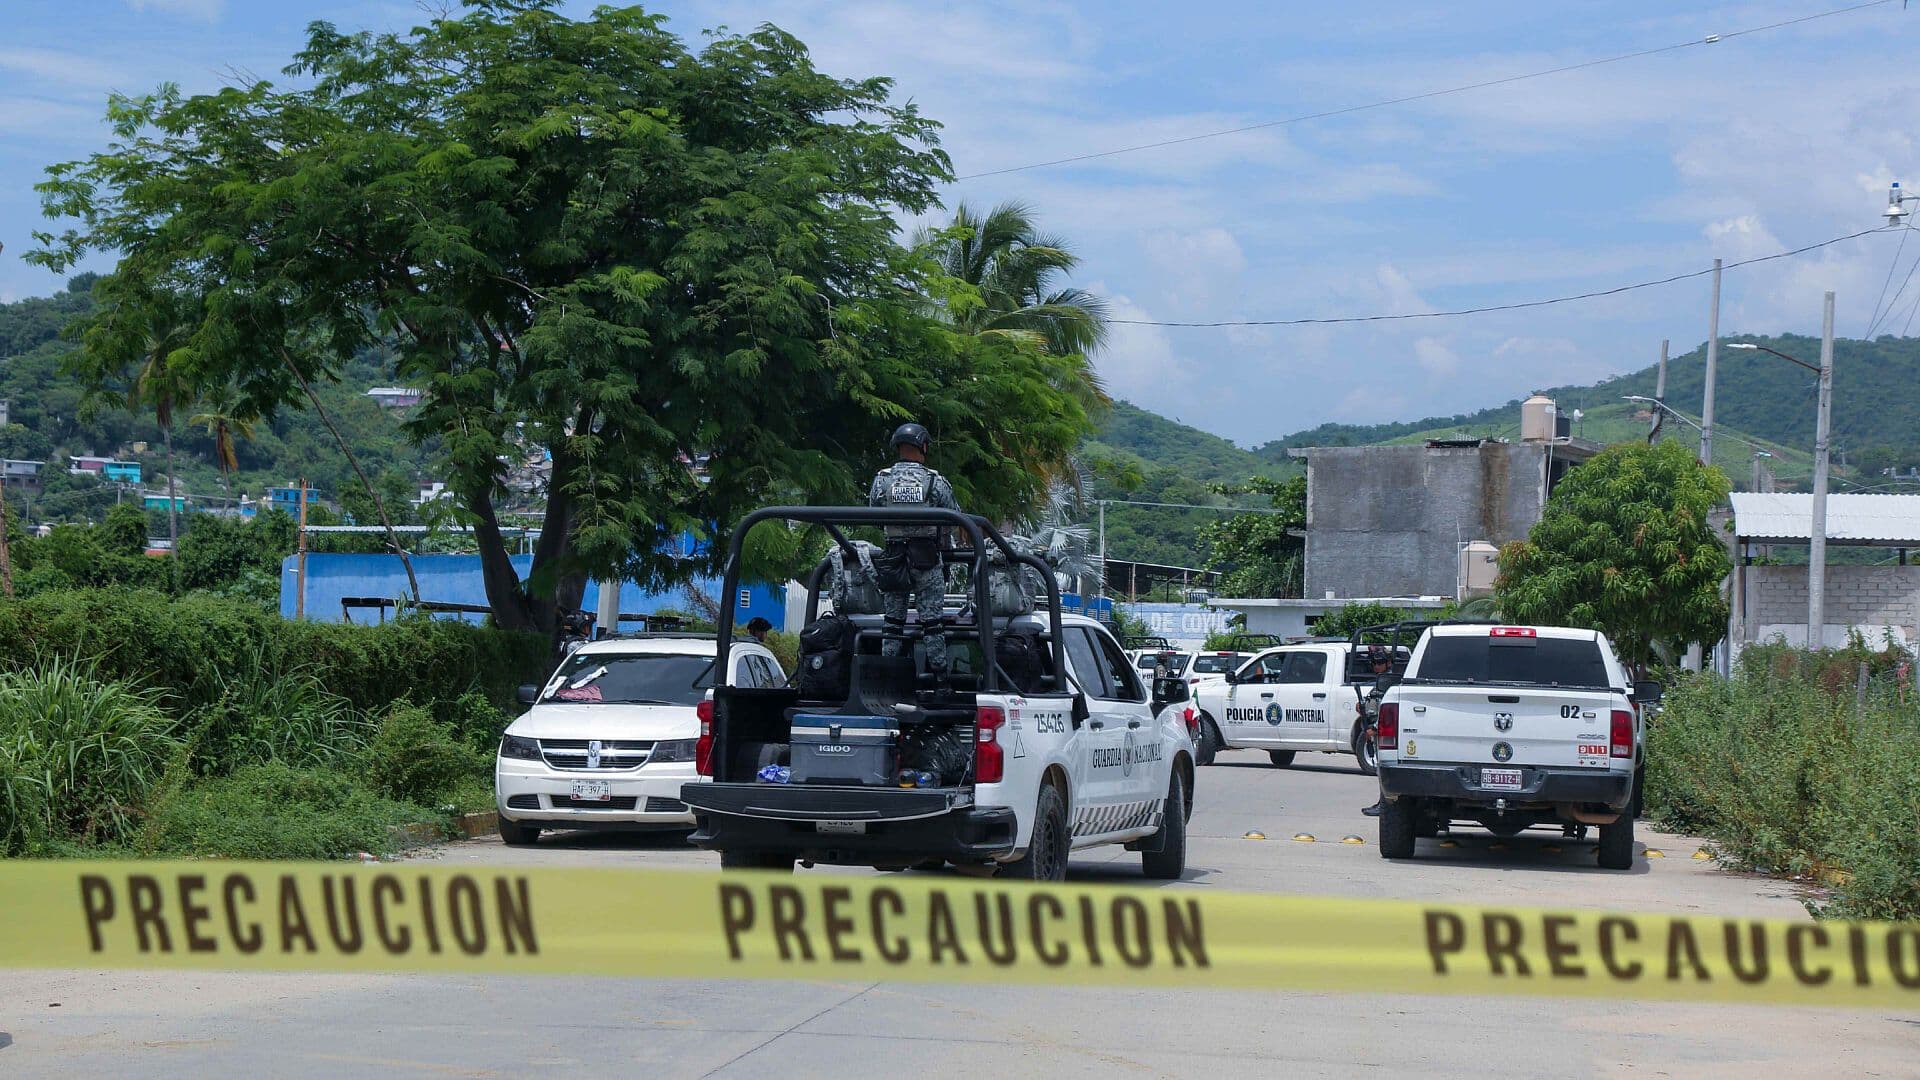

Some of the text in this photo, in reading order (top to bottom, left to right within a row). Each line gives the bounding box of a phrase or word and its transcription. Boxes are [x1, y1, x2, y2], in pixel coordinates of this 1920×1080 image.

[892, 494, 922, 502] NACIONAL
[1151, 613, 1174, 632] DE
[1226, 706, 1325, 723] POLICÍA MINISTERIAL
[1561, 705, 1580, 719] 02
[1034, 713, 1065, 733] 25426
[1092, 743, 1162, 768] GUARDIA NACIONAL
[1579, 745, 1607, 754] 911
[78, 872, 540, 956] PRECAUCION
[718, 882, 1211, 969] PRECAUCION
[1423, 910, 1920, 990] PRECAUCIO
